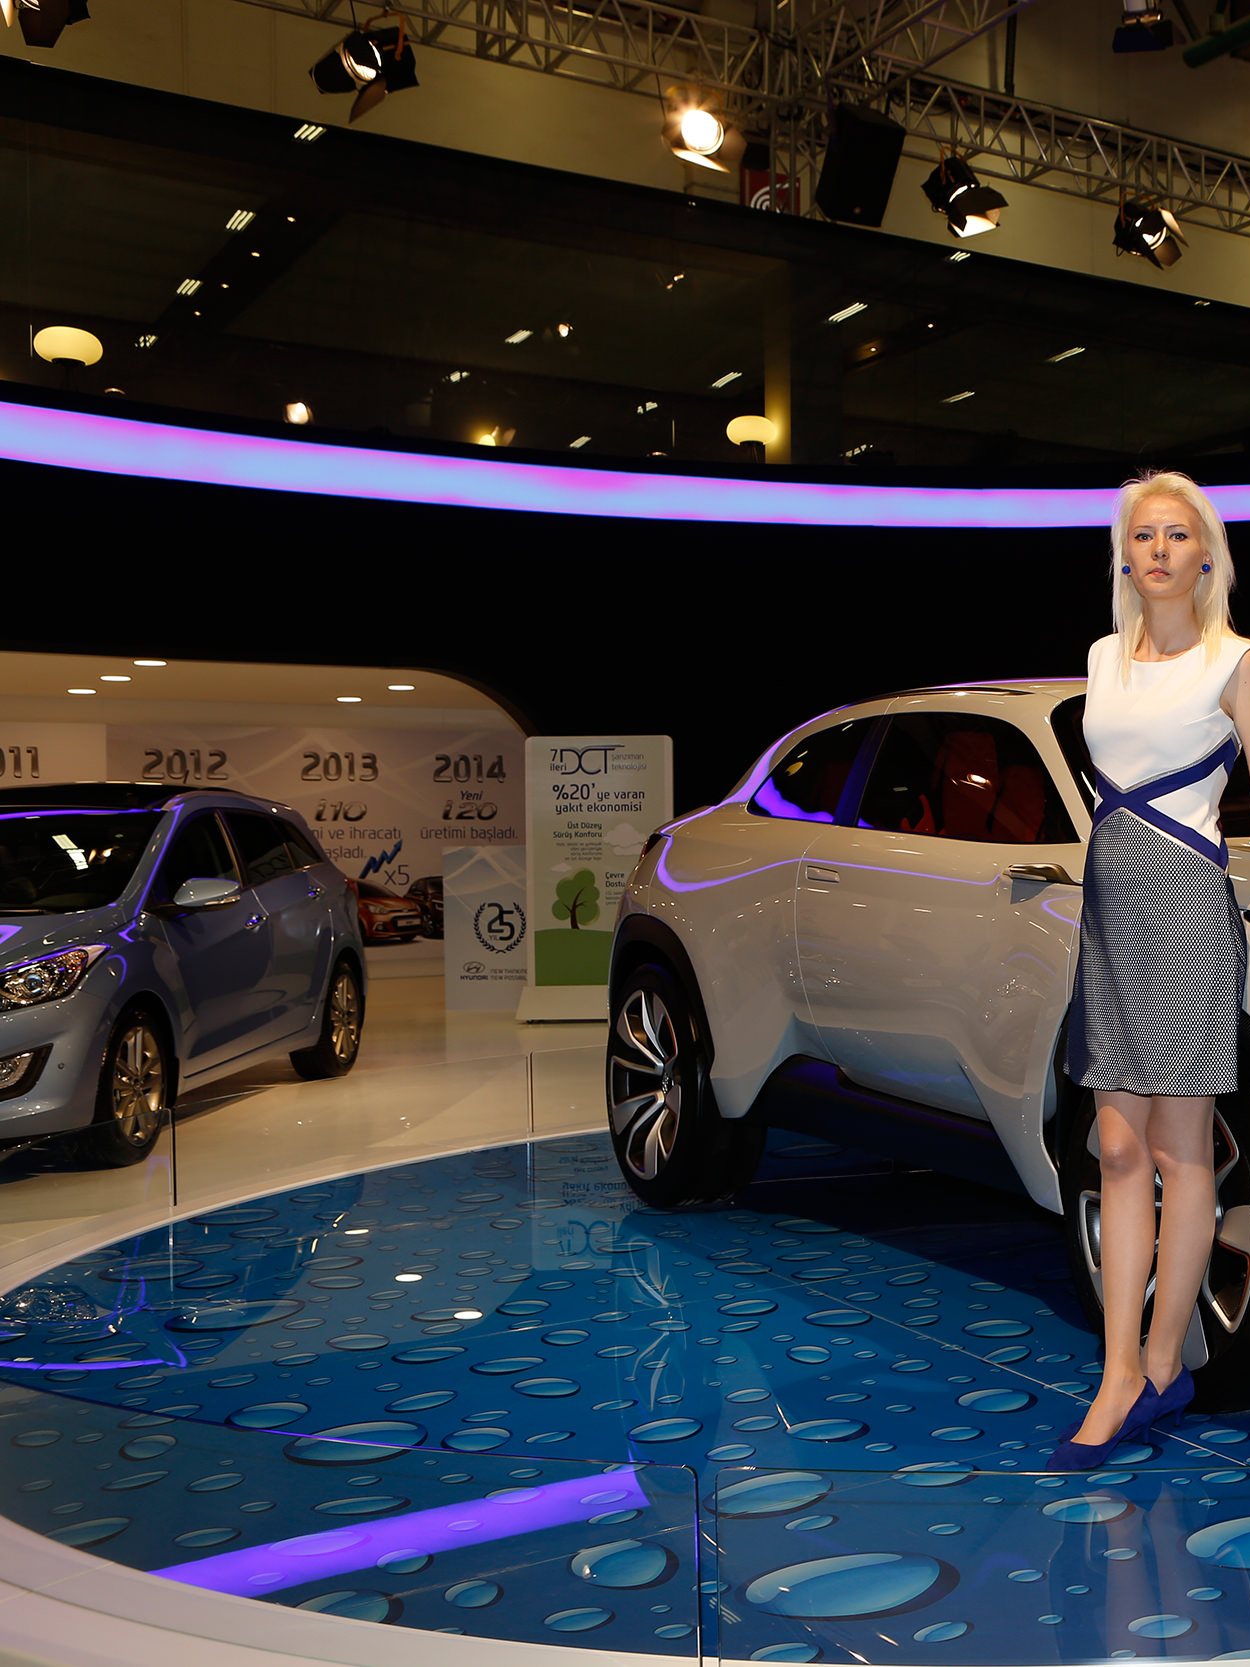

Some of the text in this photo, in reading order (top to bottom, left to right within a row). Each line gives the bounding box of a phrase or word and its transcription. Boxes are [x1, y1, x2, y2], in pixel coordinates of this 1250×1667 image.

[0, 746, 39, 778] 11
[142, 749, 228, 780] 2012
[301, 752, 379, 781] 2013
[433, 754, 506, 783] 2014
[550, 763, 567, 771] ileri
[460, 790, 484, 800] Yeni
[614, 791, 645, 799] varan
[315, 799, 368, 821] i10
[442, 800, 498, 820] i20
[555, 801, 642, 815] yakıt ekonomisi
[328, 830, 345, 839] ve
[350, 826, 401, 839] ihracatı
[567, 821, 602, 830] Üst Düzey
[420, 826, 518, 842] üretimi başladı.
[553, 831, 573, 840] Sürüş
[324, 845, 366, 862] aşladı.
[384, 865, 409, 885] x5
[605, 871, 625, 880] Çevre
[487, 903, 515, 940] 25
